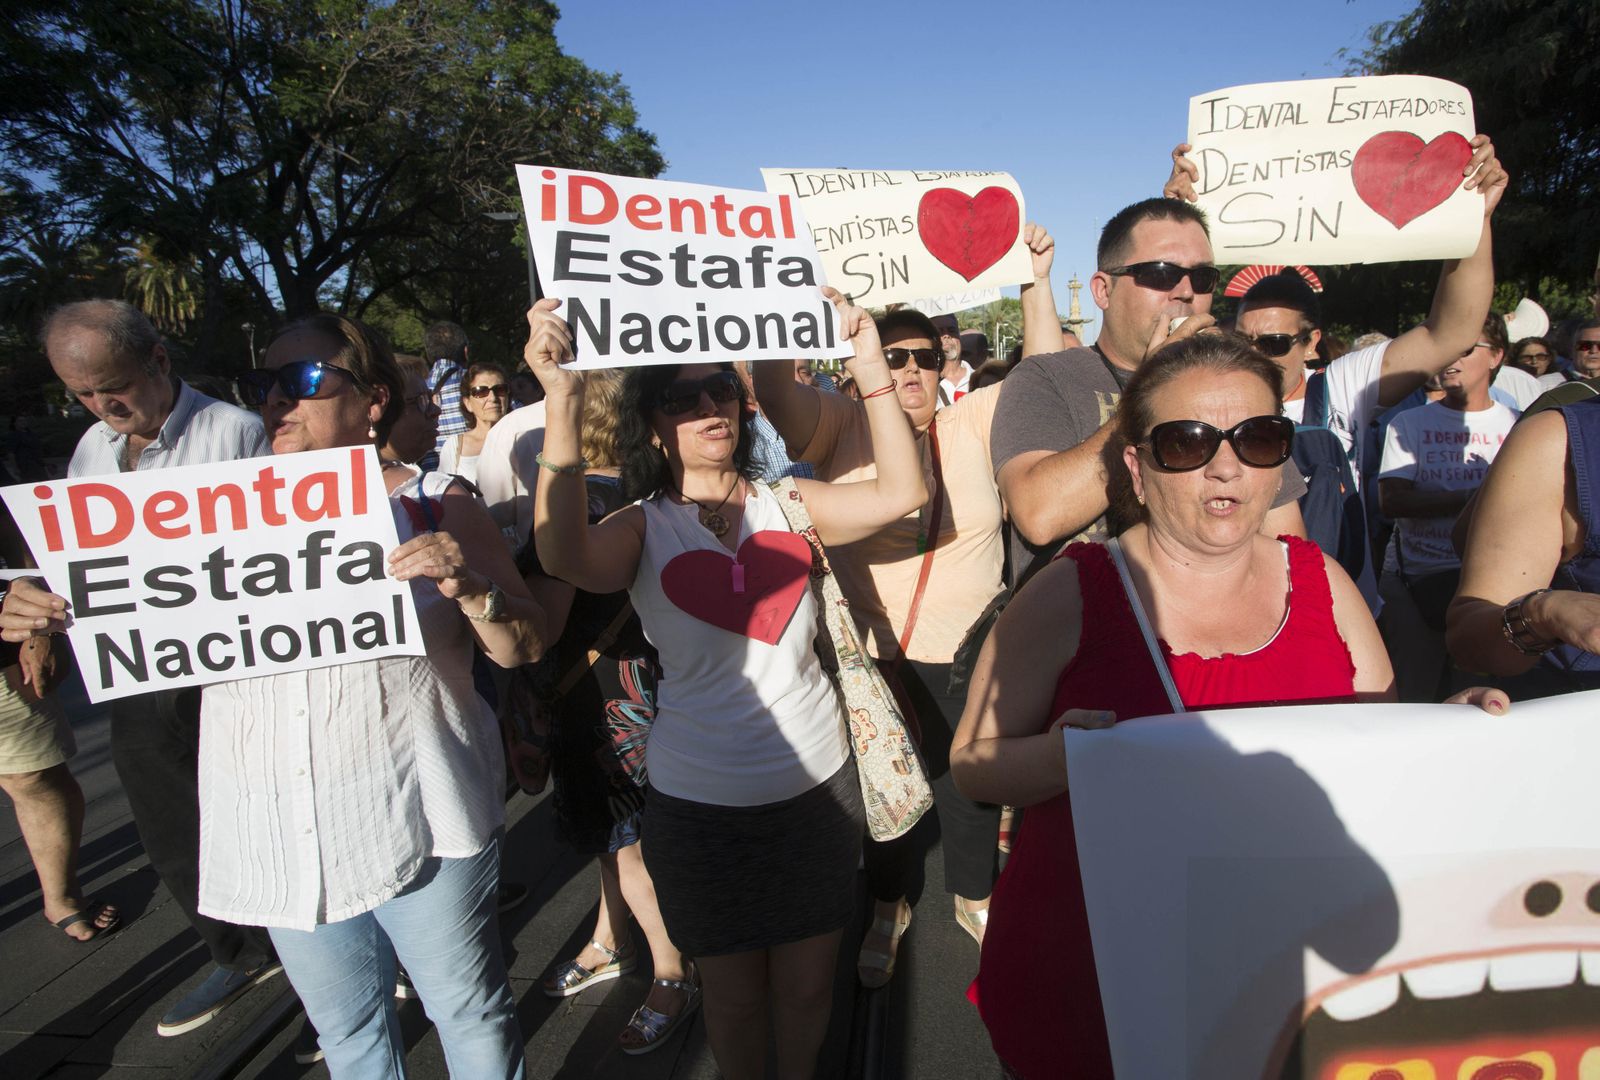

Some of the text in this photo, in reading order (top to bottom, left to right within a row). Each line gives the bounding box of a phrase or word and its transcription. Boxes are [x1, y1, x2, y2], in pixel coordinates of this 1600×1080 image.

[1198, 86, 1466, 134] IDENTAL ESTAFADORES
[541, 169, 796, 239] iDental
[780, 171, 902, 198] IDENTAL
[806, 215, 914, 252] ENTiSTAS
[1218, 192, 1343, 248] SiN
[553, 230, 817, 289] Estafa
[842, 252, 910, 301] SiN
[567, 297, 836, 356] Nacional
[1422, 430, 1491, 446] IDENTAL
[32, 448, 369, 552] iDental
[67, 530, 388, 619] Estafa
[94, 594, 407, 690] Nacional
